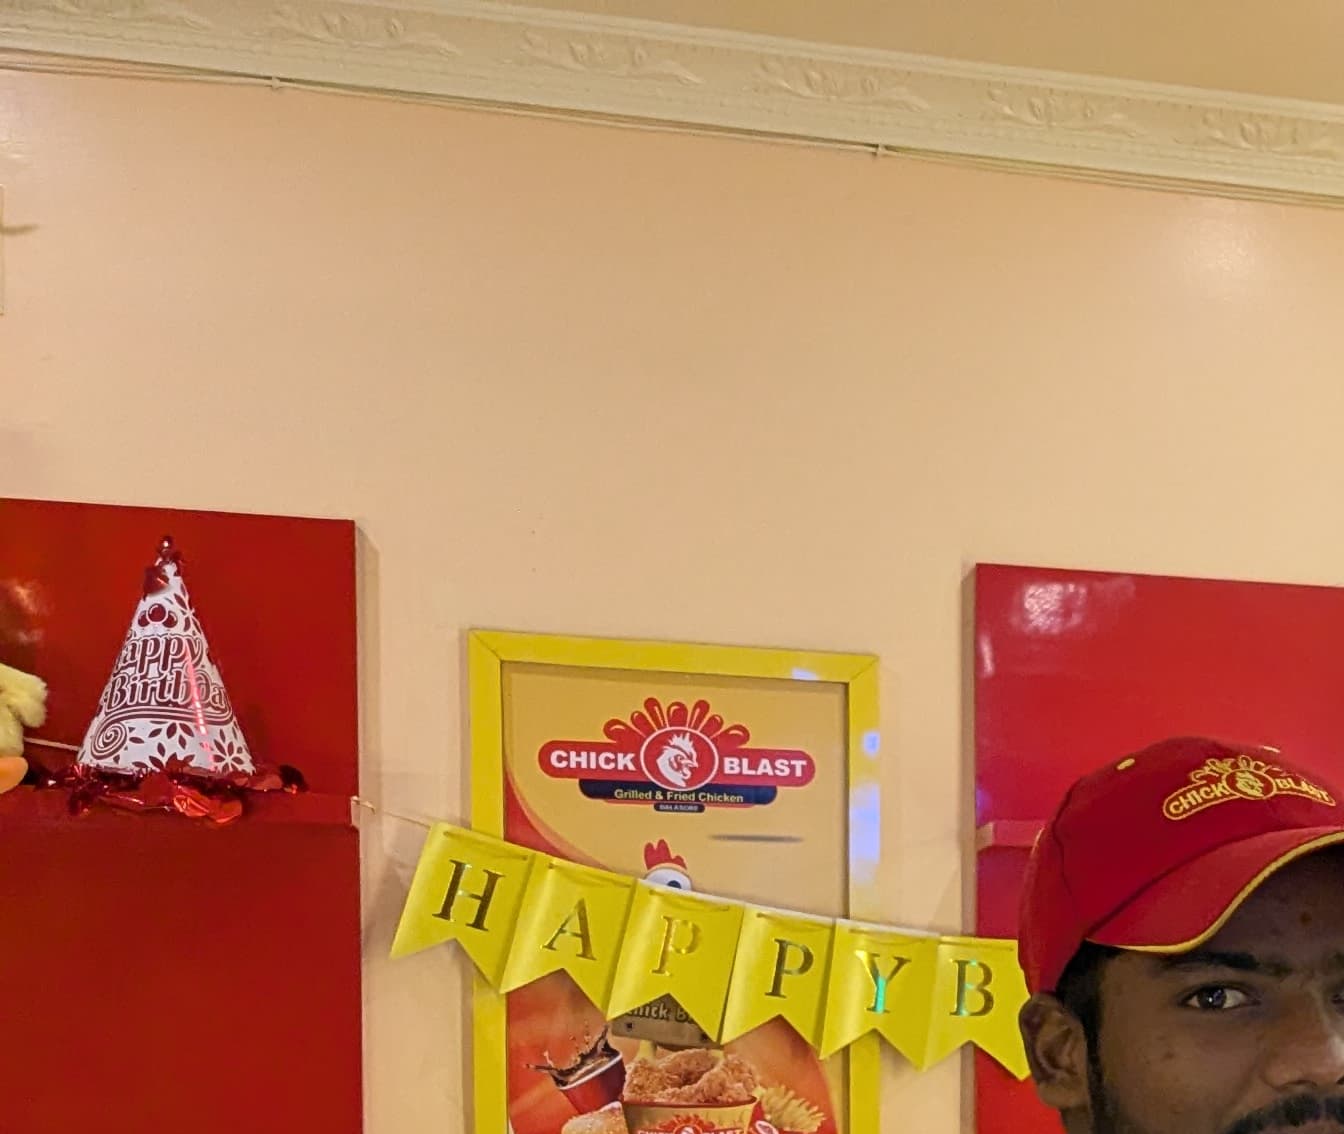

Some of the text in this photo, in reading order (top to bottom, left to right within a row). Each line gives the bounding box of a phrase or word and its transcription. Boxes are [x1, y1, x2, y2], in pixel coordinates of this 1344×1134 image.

[113, 632, 208, 678] appy
[105, 667, 228, 712] Birthda
[549, 750, 807, 778] CHICK BLAST
[614, 789, 744, 803] Grilled & Fried Chicken
[1169, 782, 1229, 815] CHICK
